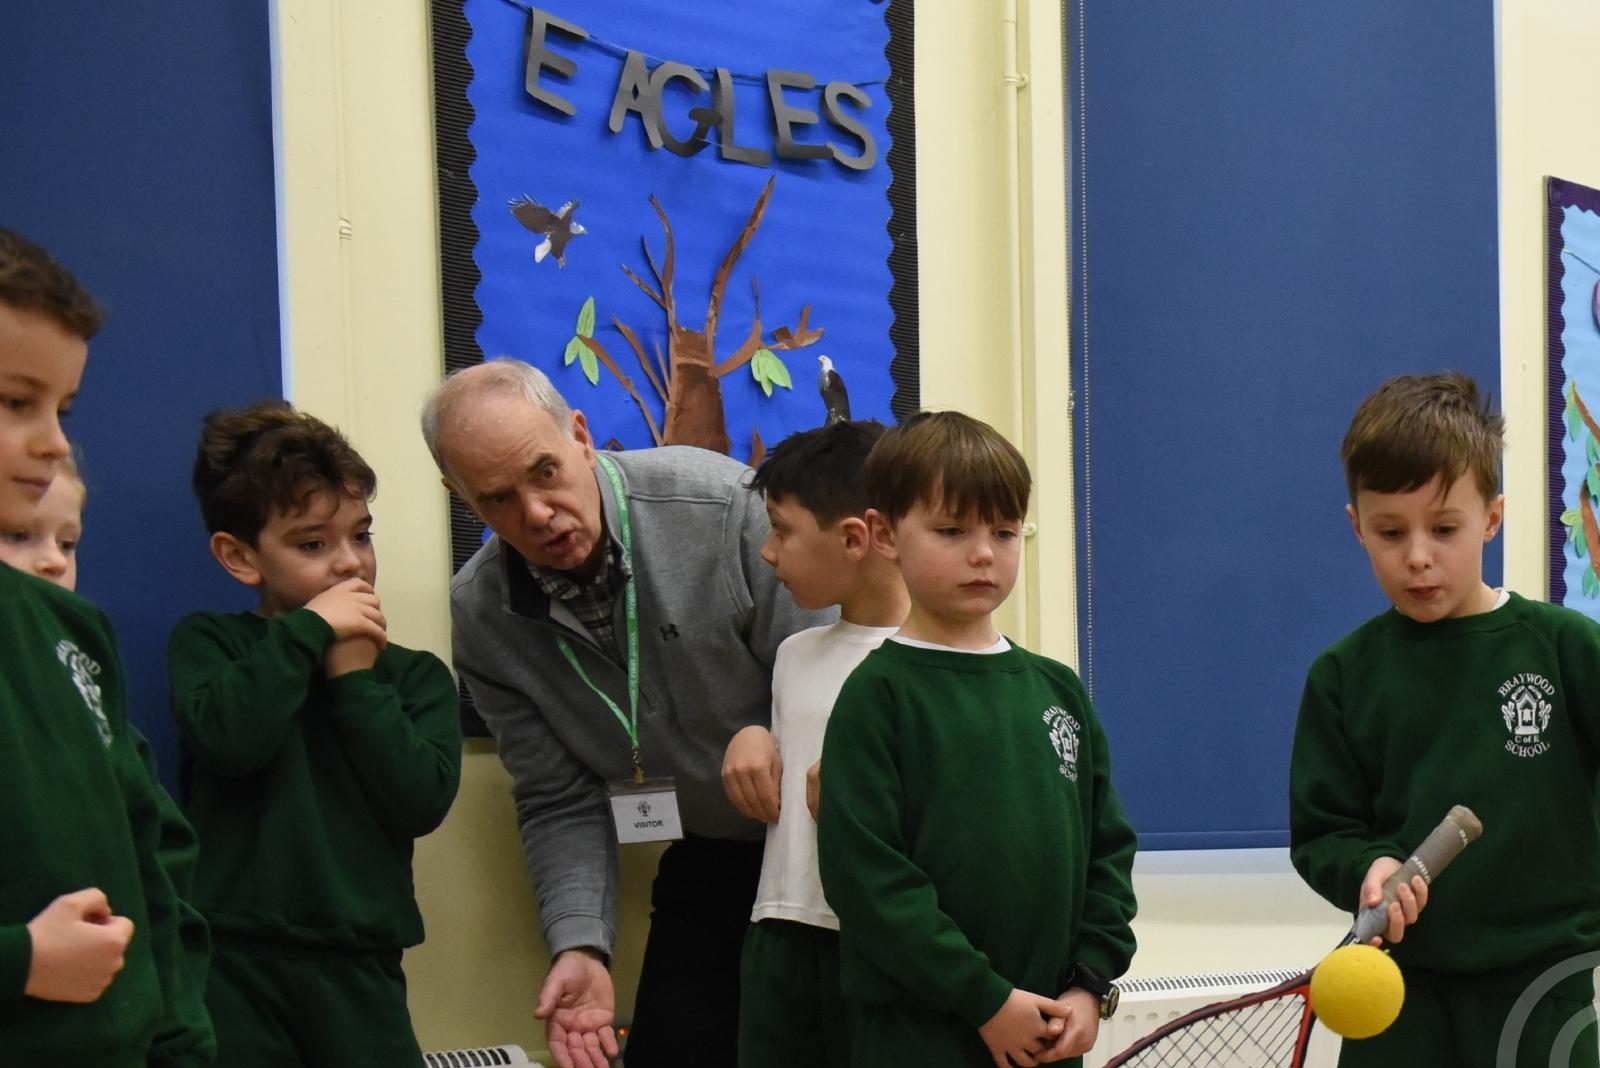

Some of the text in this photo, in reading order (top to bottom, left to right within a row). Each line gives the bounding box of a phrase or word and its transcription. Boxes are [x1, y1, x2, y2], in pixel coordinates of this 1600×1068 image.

[525, 8, 877, 171] EAGLES
[1498, 673, 1555, 697] BRAYWOOD
[1504, 740, 1551, 757] SCHOOL
[633, 819, 664, 829] VISITOR
